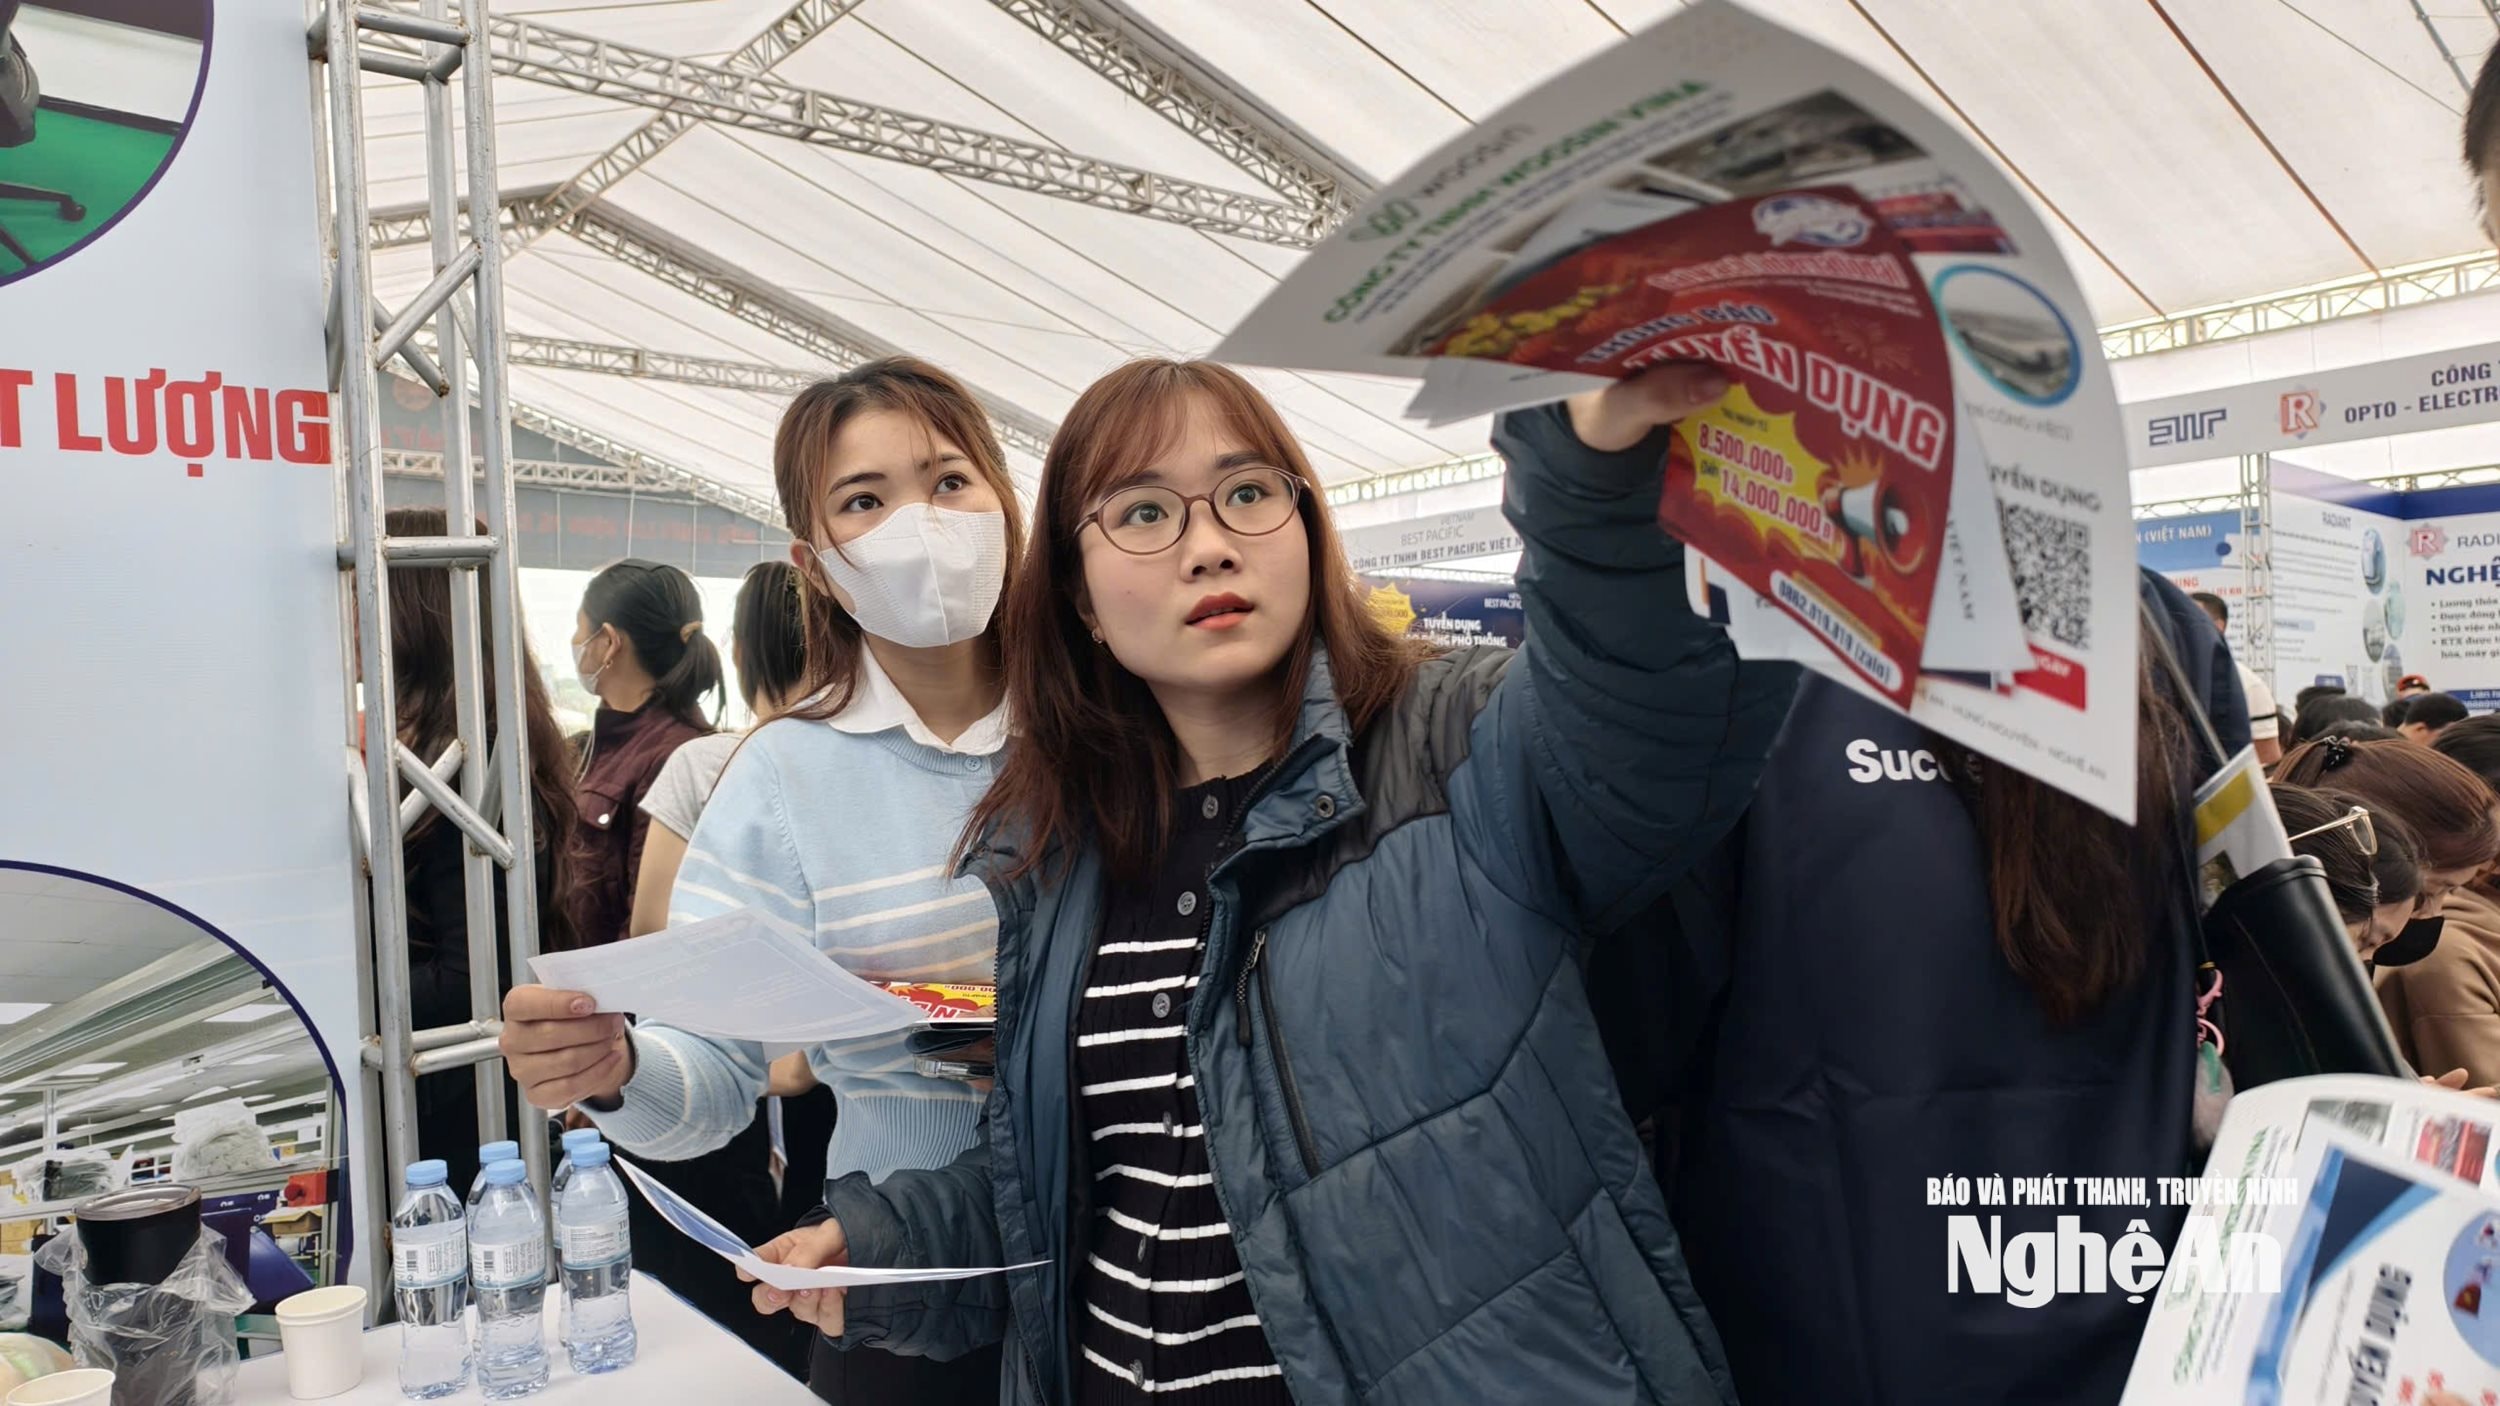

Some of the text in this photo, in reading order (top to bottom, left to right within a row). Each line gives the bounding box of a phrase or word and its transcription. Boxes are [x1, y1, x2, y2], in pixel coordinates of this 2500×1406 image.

[2431, 362, 2492, 387] CÔNG
[55, 367, 331, 478] LƯỢNG
[1806, 350, 1946, 472] DỤNG
[2345, 400, 2396, 424] OPTO
[1401, 525, 1465, 546] BEST PACIFIC
[1420, 548, 1445, 562] BEST
[1447, 540, 1486, 557] PACIFIC
[1454, 617, 1482, 632] DỤNG
